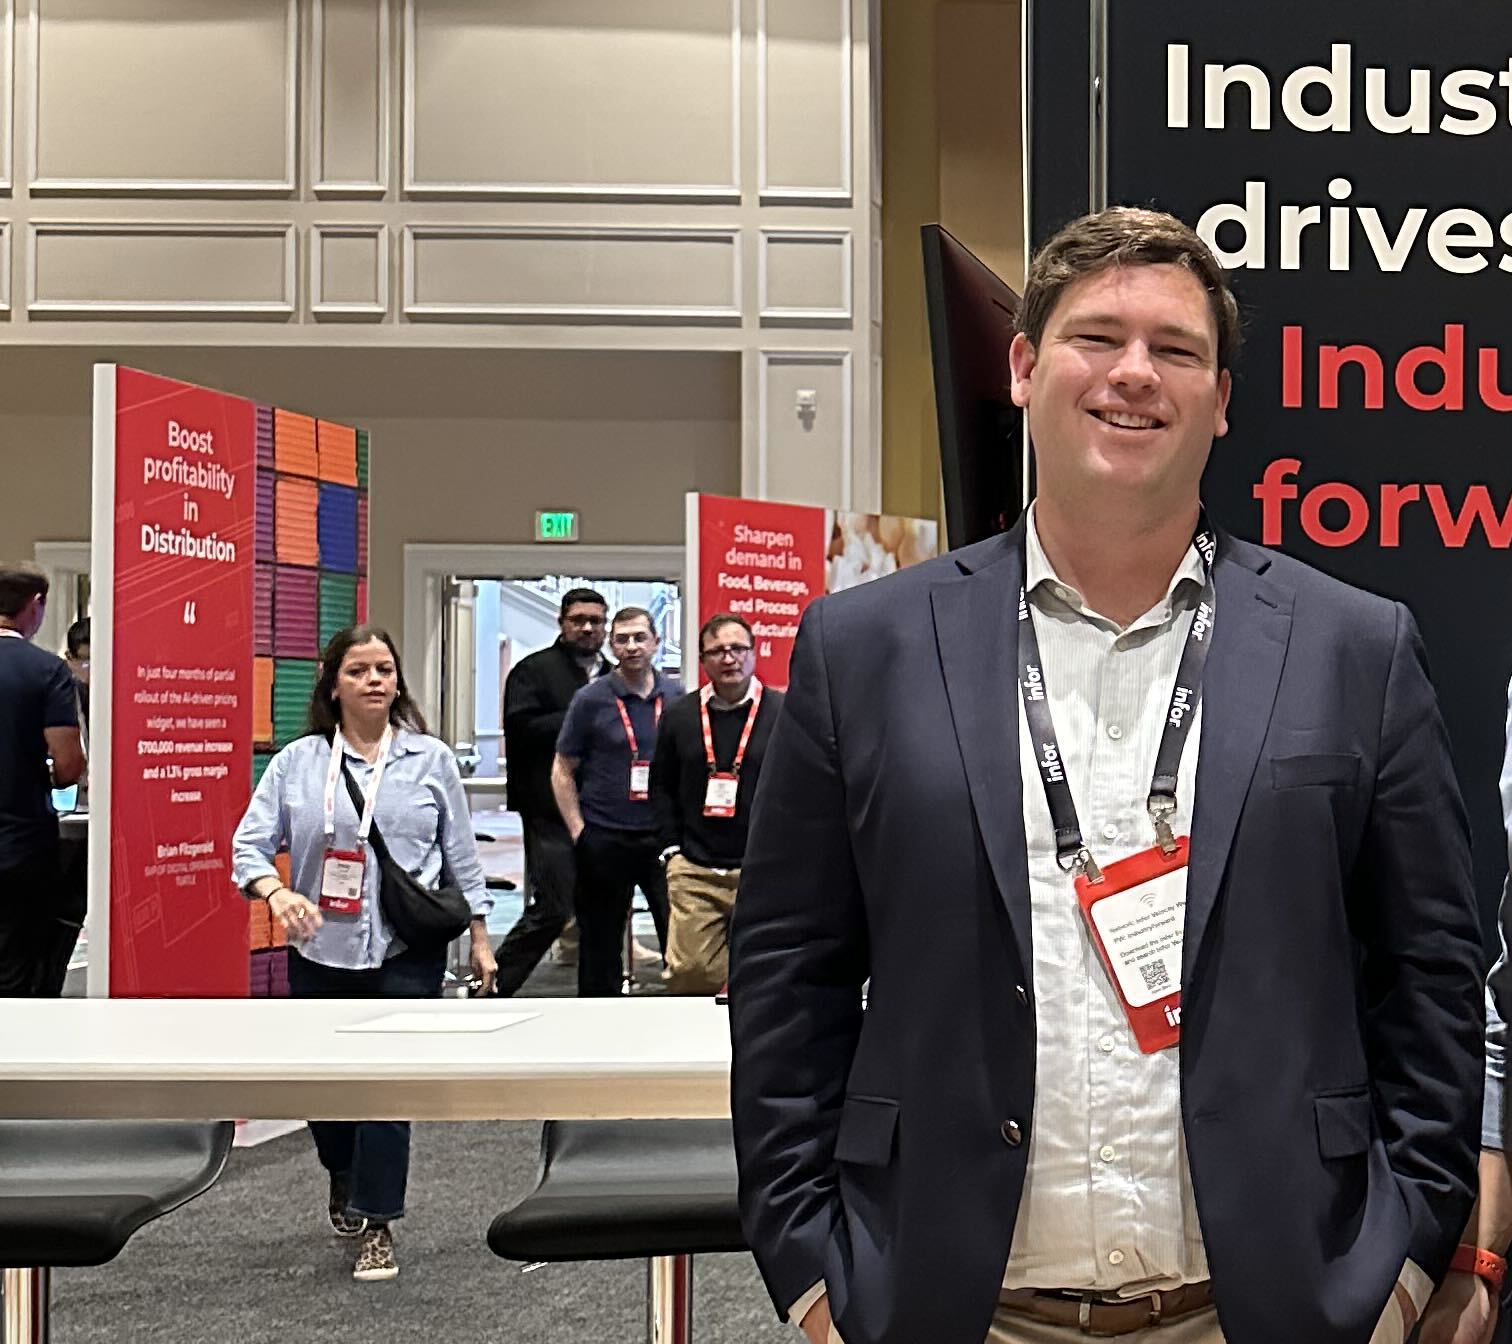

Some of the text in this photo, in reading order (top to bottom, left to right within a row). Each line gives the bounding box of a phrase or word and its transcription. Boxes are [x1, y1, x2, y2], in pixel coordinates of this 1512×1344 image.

[168, 420, 214, 454] Boost
[144, 456, 235, 500] profitability
[183, 492, 199, 522] in
[541, 512, 574, 538] EXIT
[734, 524, 794, 549] Sharpen
[141, 523, 235, 562] Distribution
[725, 547, 802, 571] demand in
[718, 573, 809, 596] Food, Beverage,
[729, 597, 800, 616] and Process
[1192, 602, 1213, 642] infor
[1024, 664, 1045, 701] infor
[1169, 686, 1193, 728] infor
[144, 766, 159, 780] and
[160, 768, 166, 779] a
[1041, 742, 1064, 784] infor
